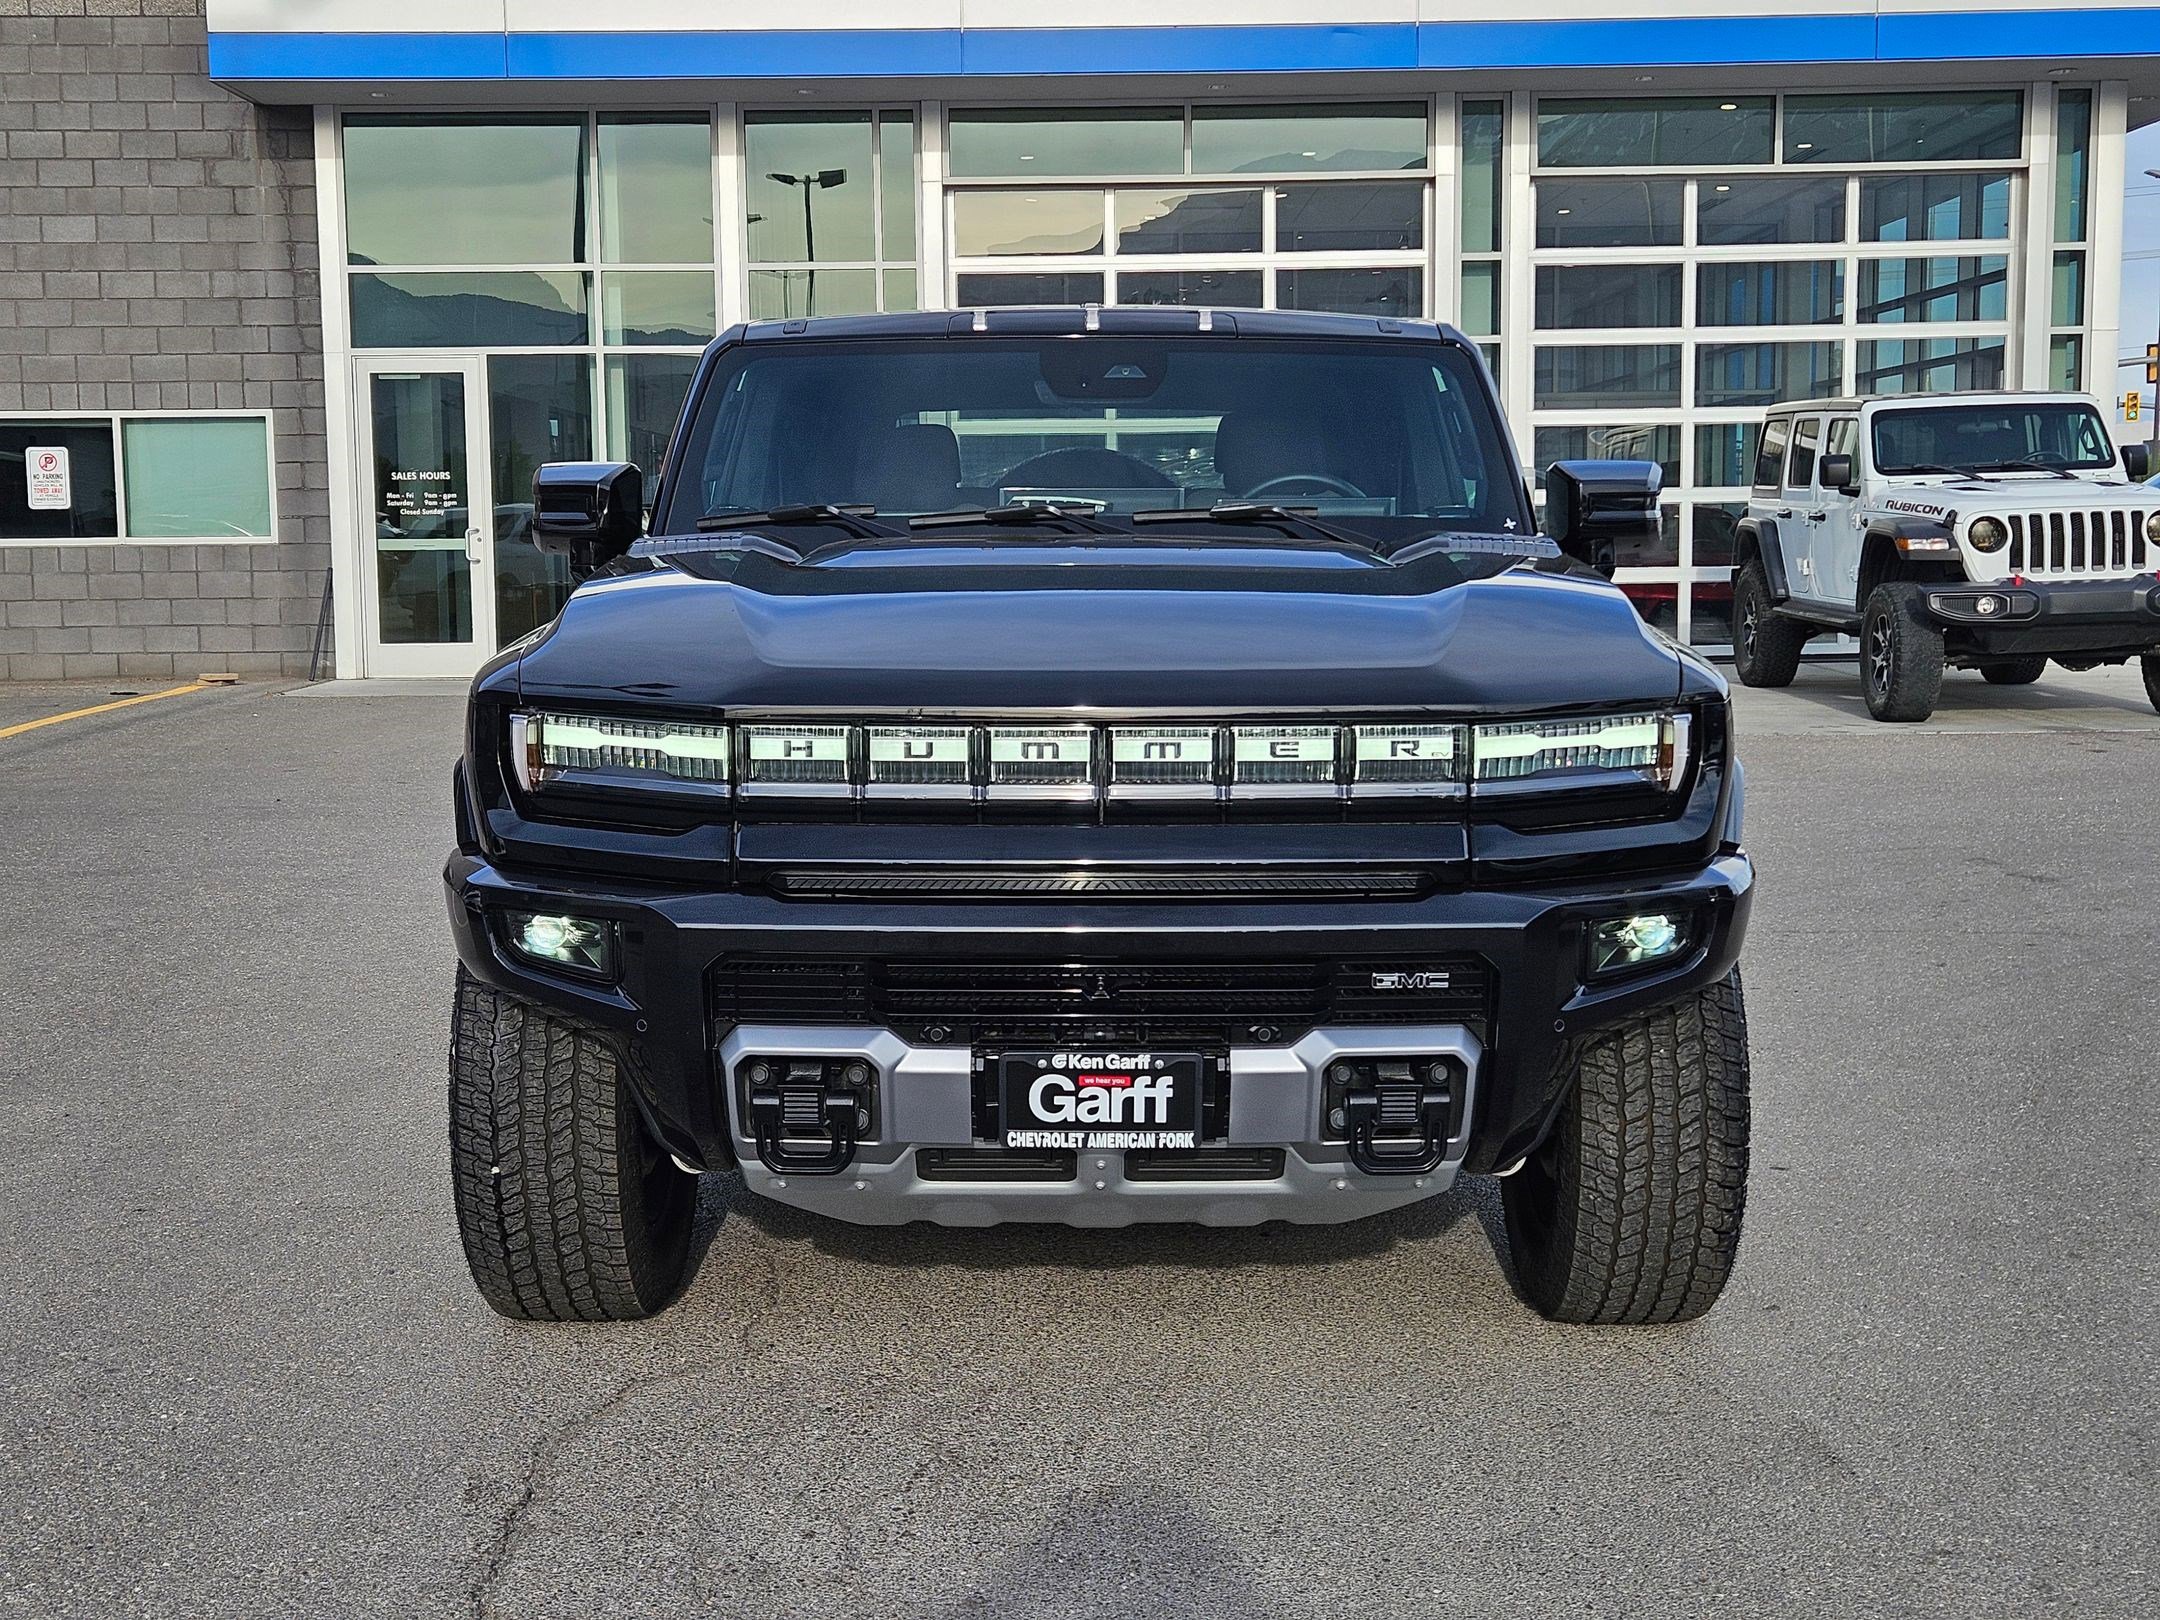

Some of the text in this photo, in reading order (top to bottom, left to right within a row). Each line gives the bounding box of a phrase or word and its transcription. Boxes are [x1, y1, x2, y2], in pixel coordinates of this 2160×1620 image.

[391, 471, 451, 480] SALES HOURS
[386, 499, 414, 507] Saturday
[405, 491, 415, 499] Fri
[421, 508, 445, 516] Sunday
[1885, 500, 1944, 516] RUBICON
[783, 739, 1420, 760] HUMMER
[1371, 972, 1449, 989] GMC
[1068, 1054, 1151, 1070] Ken Garff
[1095, 1076, 1110, 1084] hear
[1111, 1077, 1126, 1086] you
[1028, 1073, 1174, 1124] Garff
[1007, 1132, 1195, 1149] CHEVROLET AMERICAN FORK
